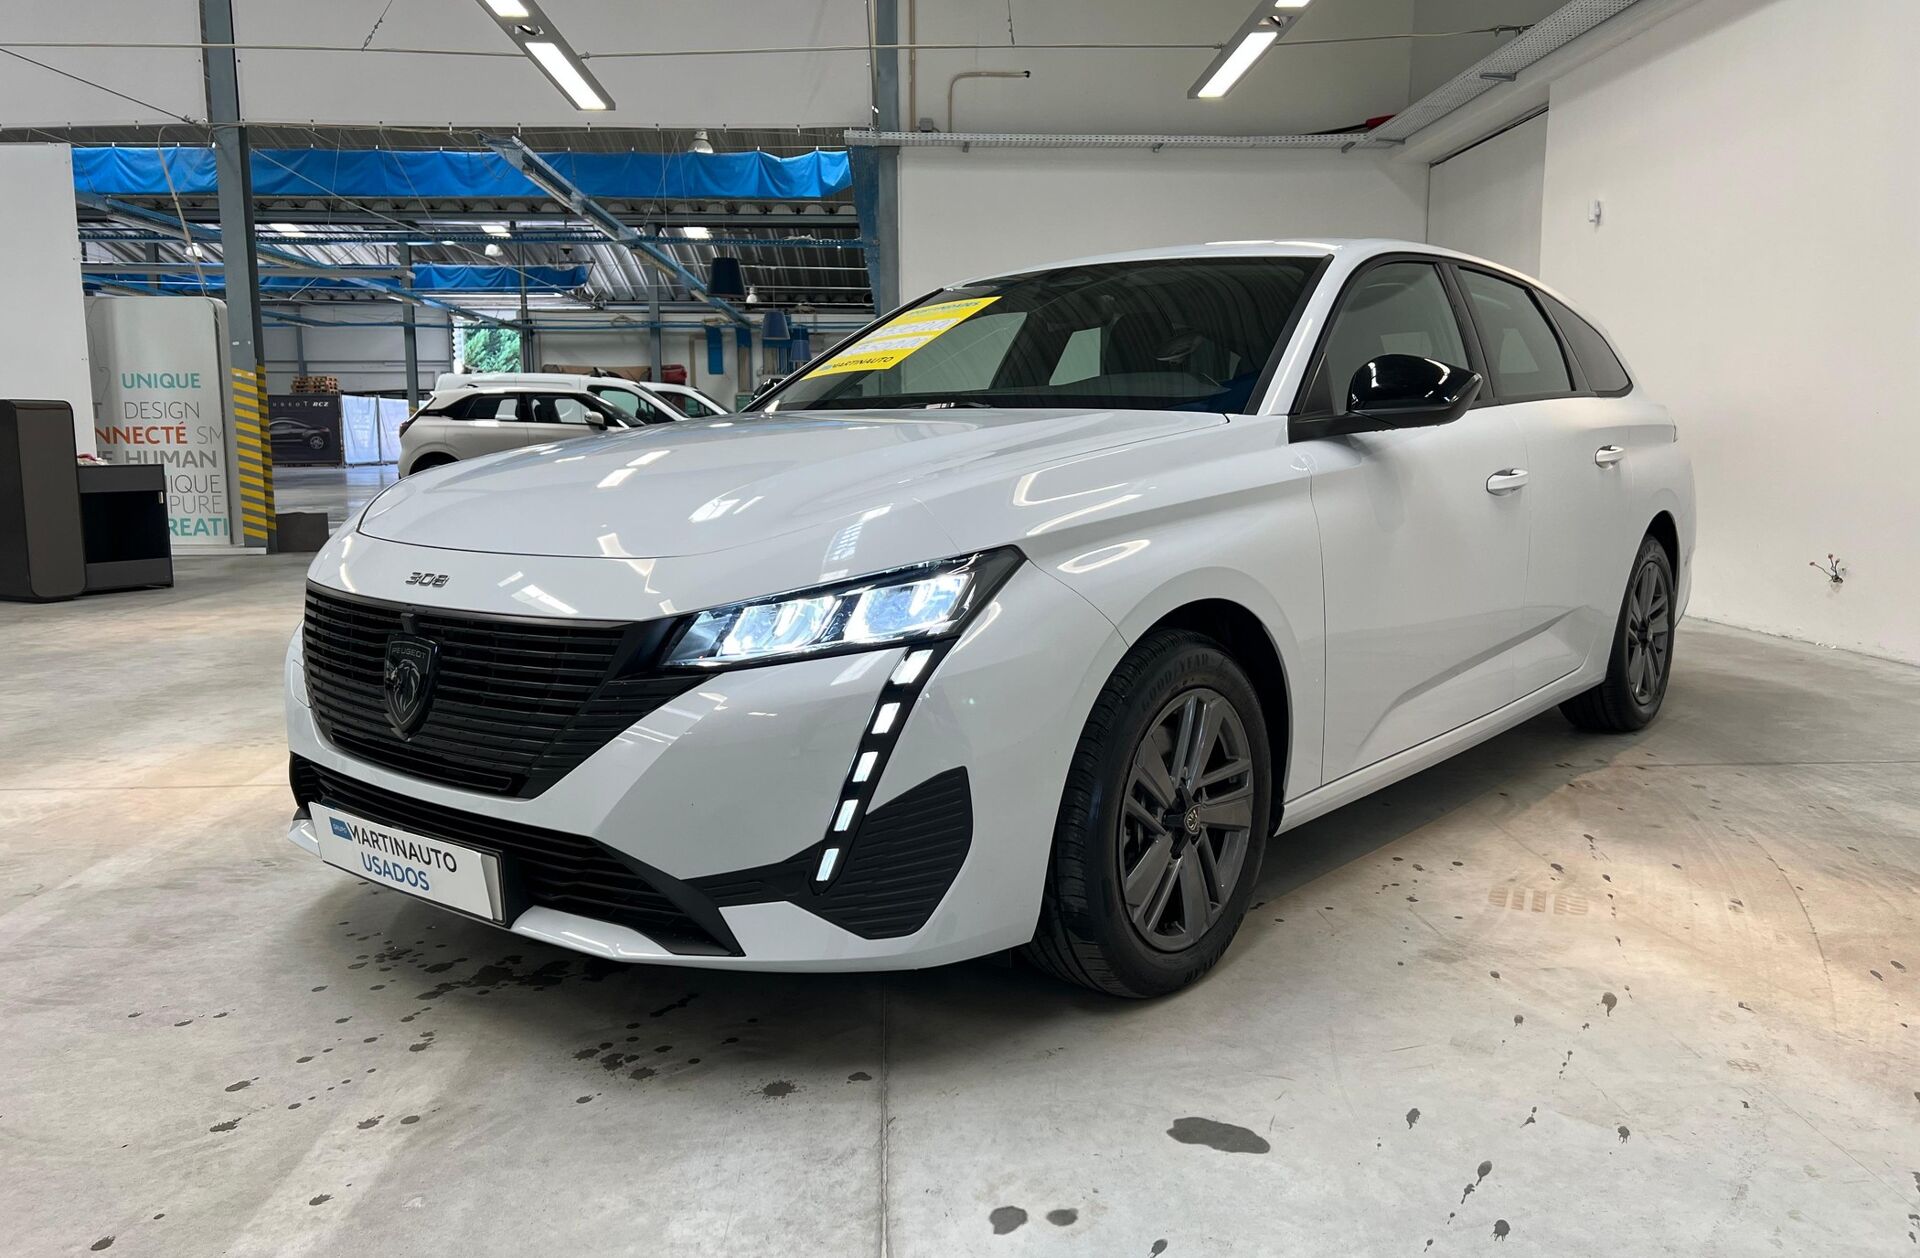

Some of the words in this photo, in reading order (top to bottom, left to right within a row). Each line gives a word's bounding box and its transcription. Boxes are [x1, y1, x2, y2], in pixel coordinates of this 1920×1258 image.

[122, 373, 201, 388] UNIQUE
[124, 401, 200, 419] DESIGN
[95, 421, 188, 444] NNECTÉ
[125, 450, 217, 468] HUMAN
[166, 474, 222, 493] IQUE
[170, 495, 224, 514] PURE
[405, 571, 449, 588] 308
[391, 647, 427, 659] PEUGEOT
[347, 822, 457, 873] MARTINAUTO
[361, 851, 430, 891] USADOS
